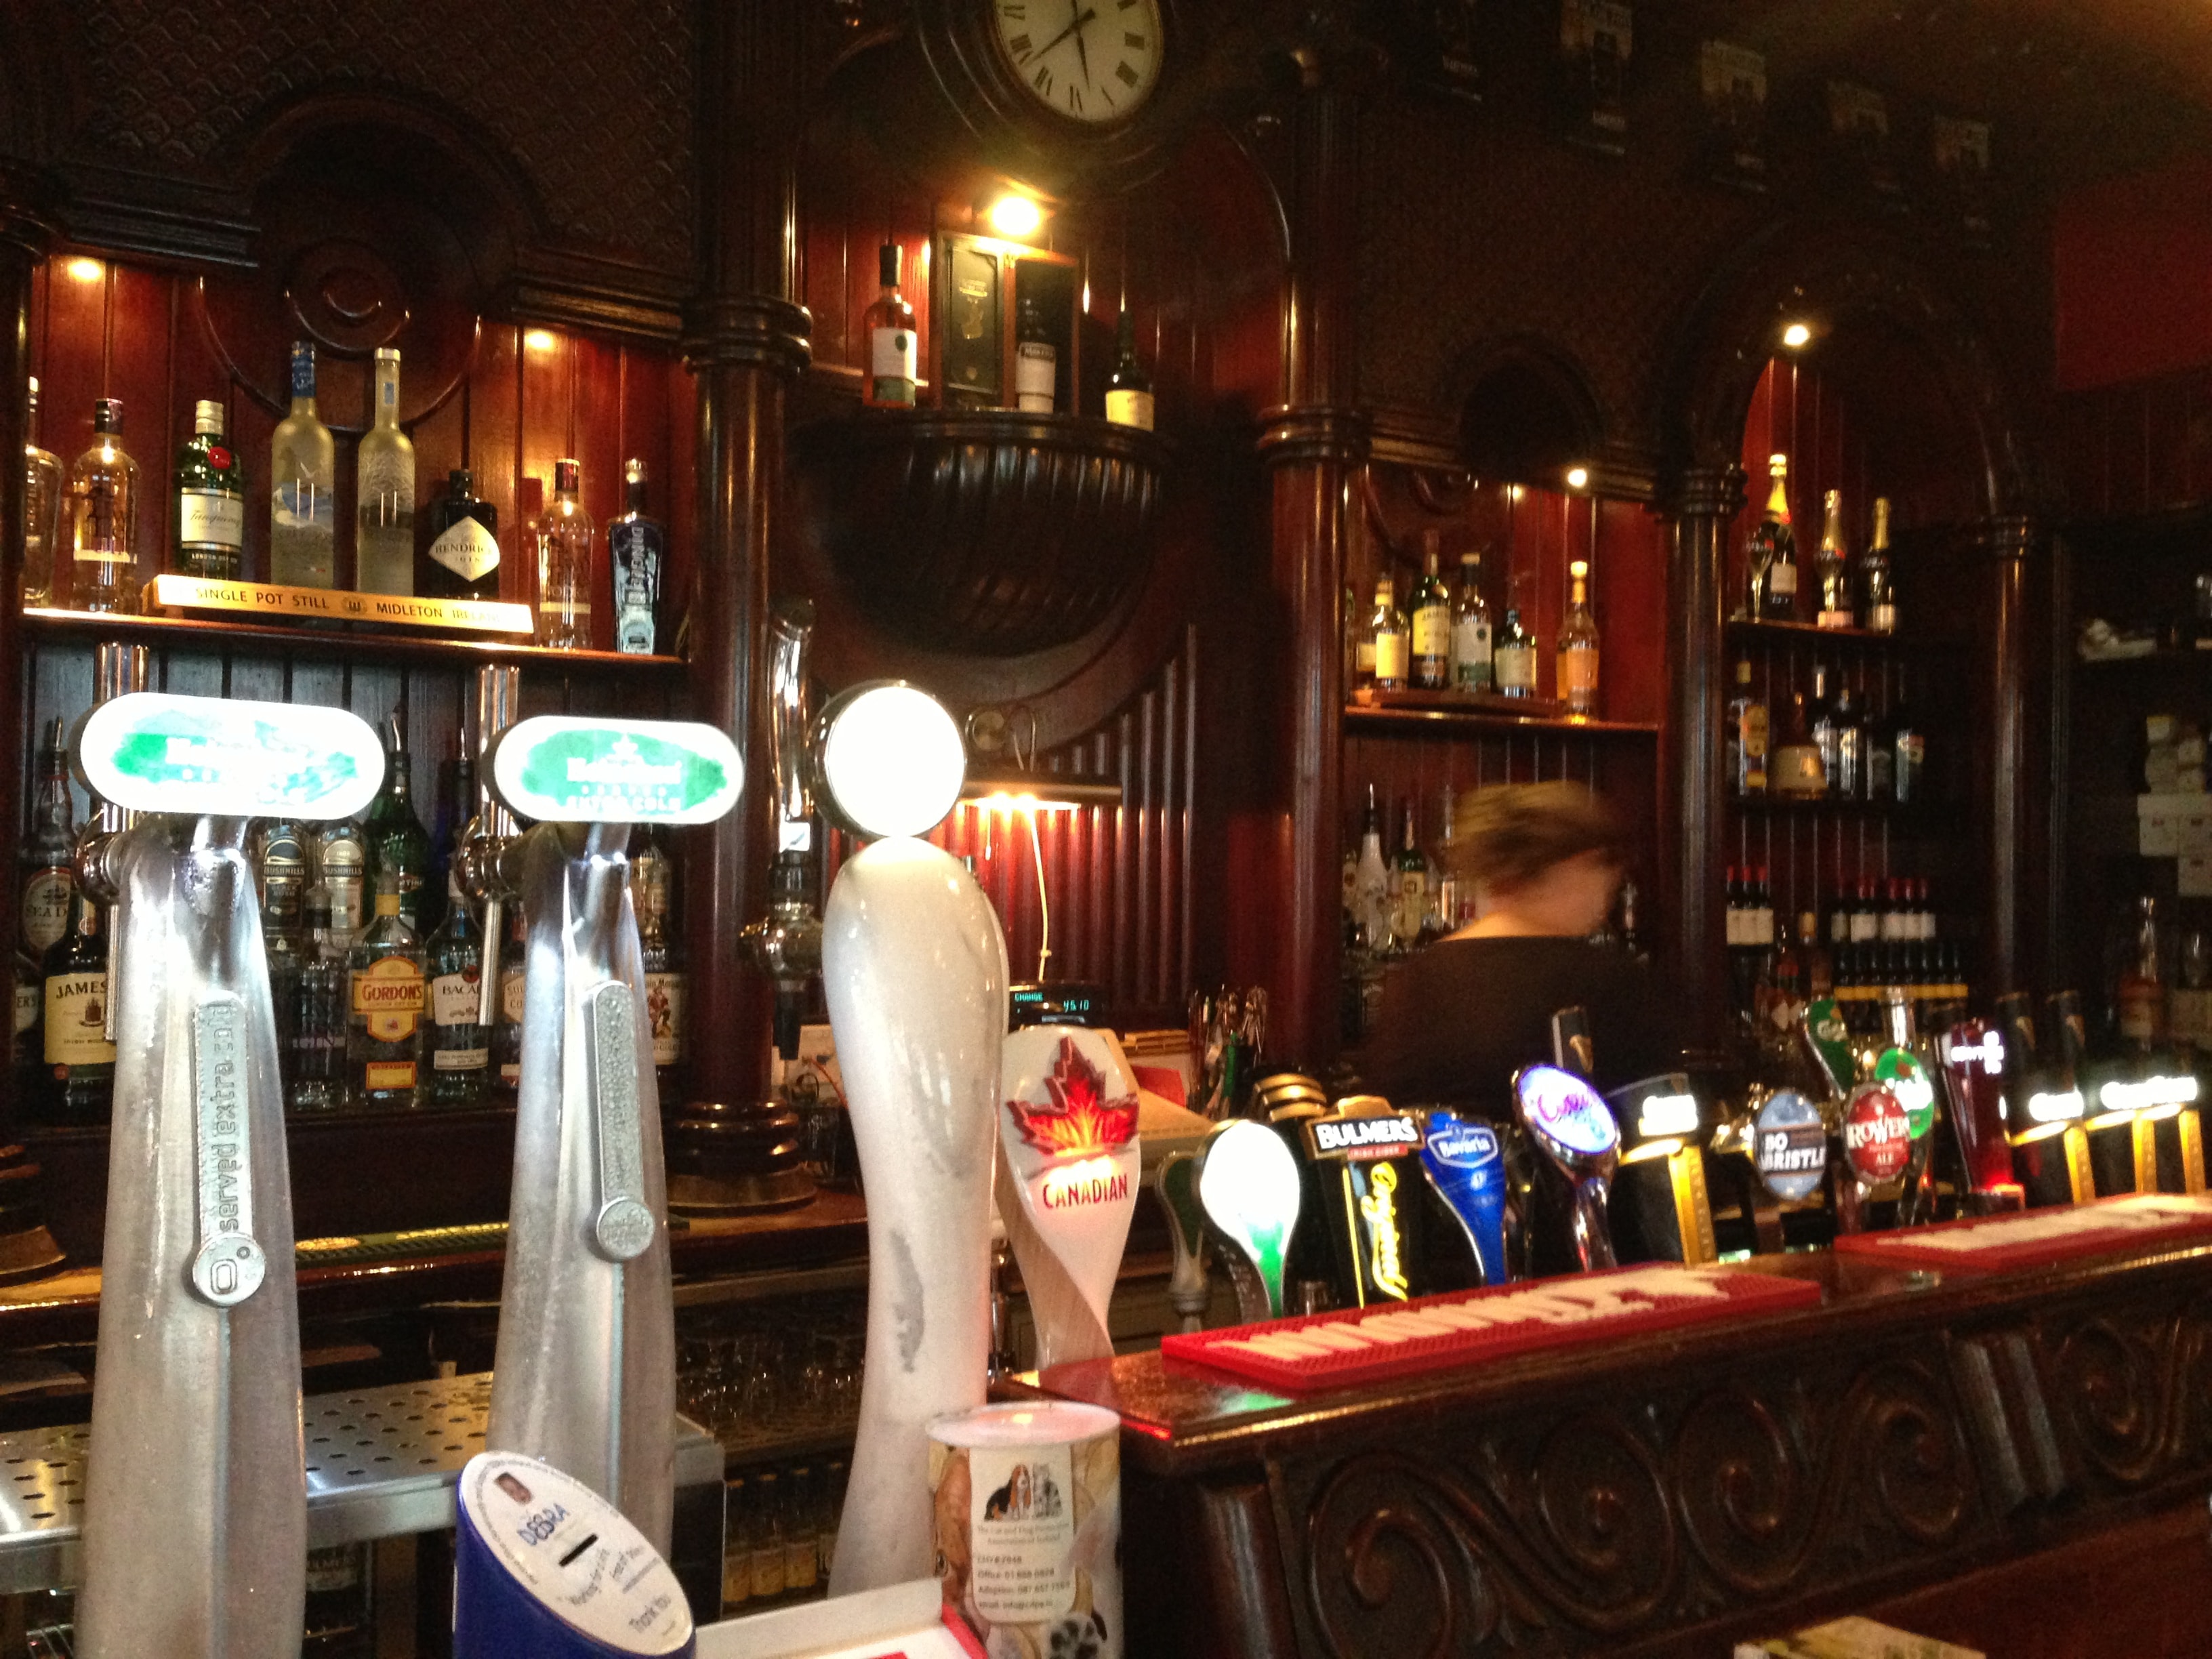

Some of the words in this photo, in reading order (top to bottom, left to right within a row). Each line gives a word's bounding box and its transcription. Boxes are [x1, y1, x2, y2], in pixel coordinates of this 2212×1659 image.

[195, 587, 248, 602] SINGLE
[256, 592, 283, 605] POT
[292, 594, 330, 609] STILL
[376, 602, 443, 618] MIDLETON
[452, 608, 501, 623] IRELAN
[265, 867, 305, 875] BUSHMILLS
[323, 867, 363, 875] BUSHMILLS
[56, 980, 108, 1000] JAMES
[211, 1062, 237, 1134] extra
[1316, 1116, 1418, 1150] BULMERS
[211, 1143, 242, 1233] served
[1042, 1174, 1128, 1210] CANADIAN
